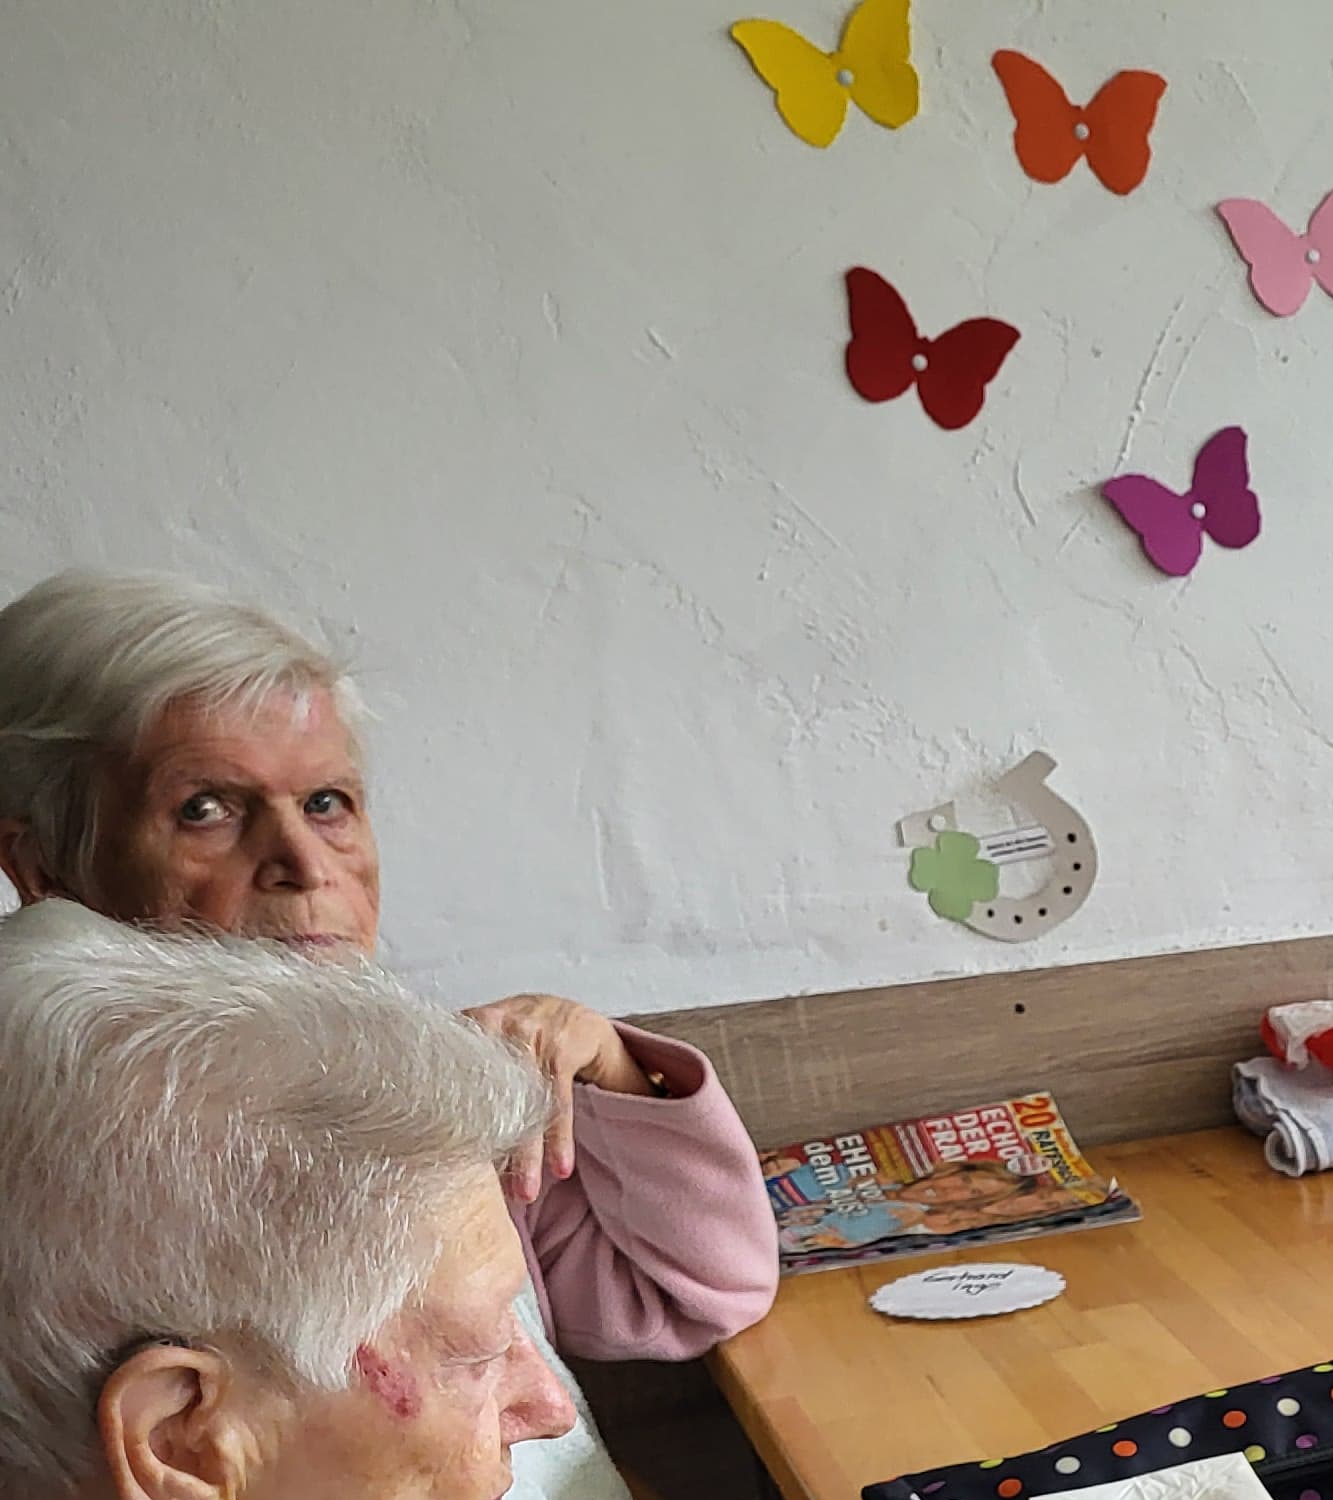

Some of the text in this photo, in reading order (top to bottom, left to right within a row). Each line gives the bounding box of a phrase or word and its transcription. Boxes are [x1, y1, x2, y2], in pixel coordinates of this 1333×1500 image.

[952, 1112, 991, 1155] DER
[981, 1108, 1025, 1161] ECHO
[1011, 1097, 1057, 1129] 20
[803, 1141, 841, 1186] dem
[835, 1134, 878, 1178] EHE
